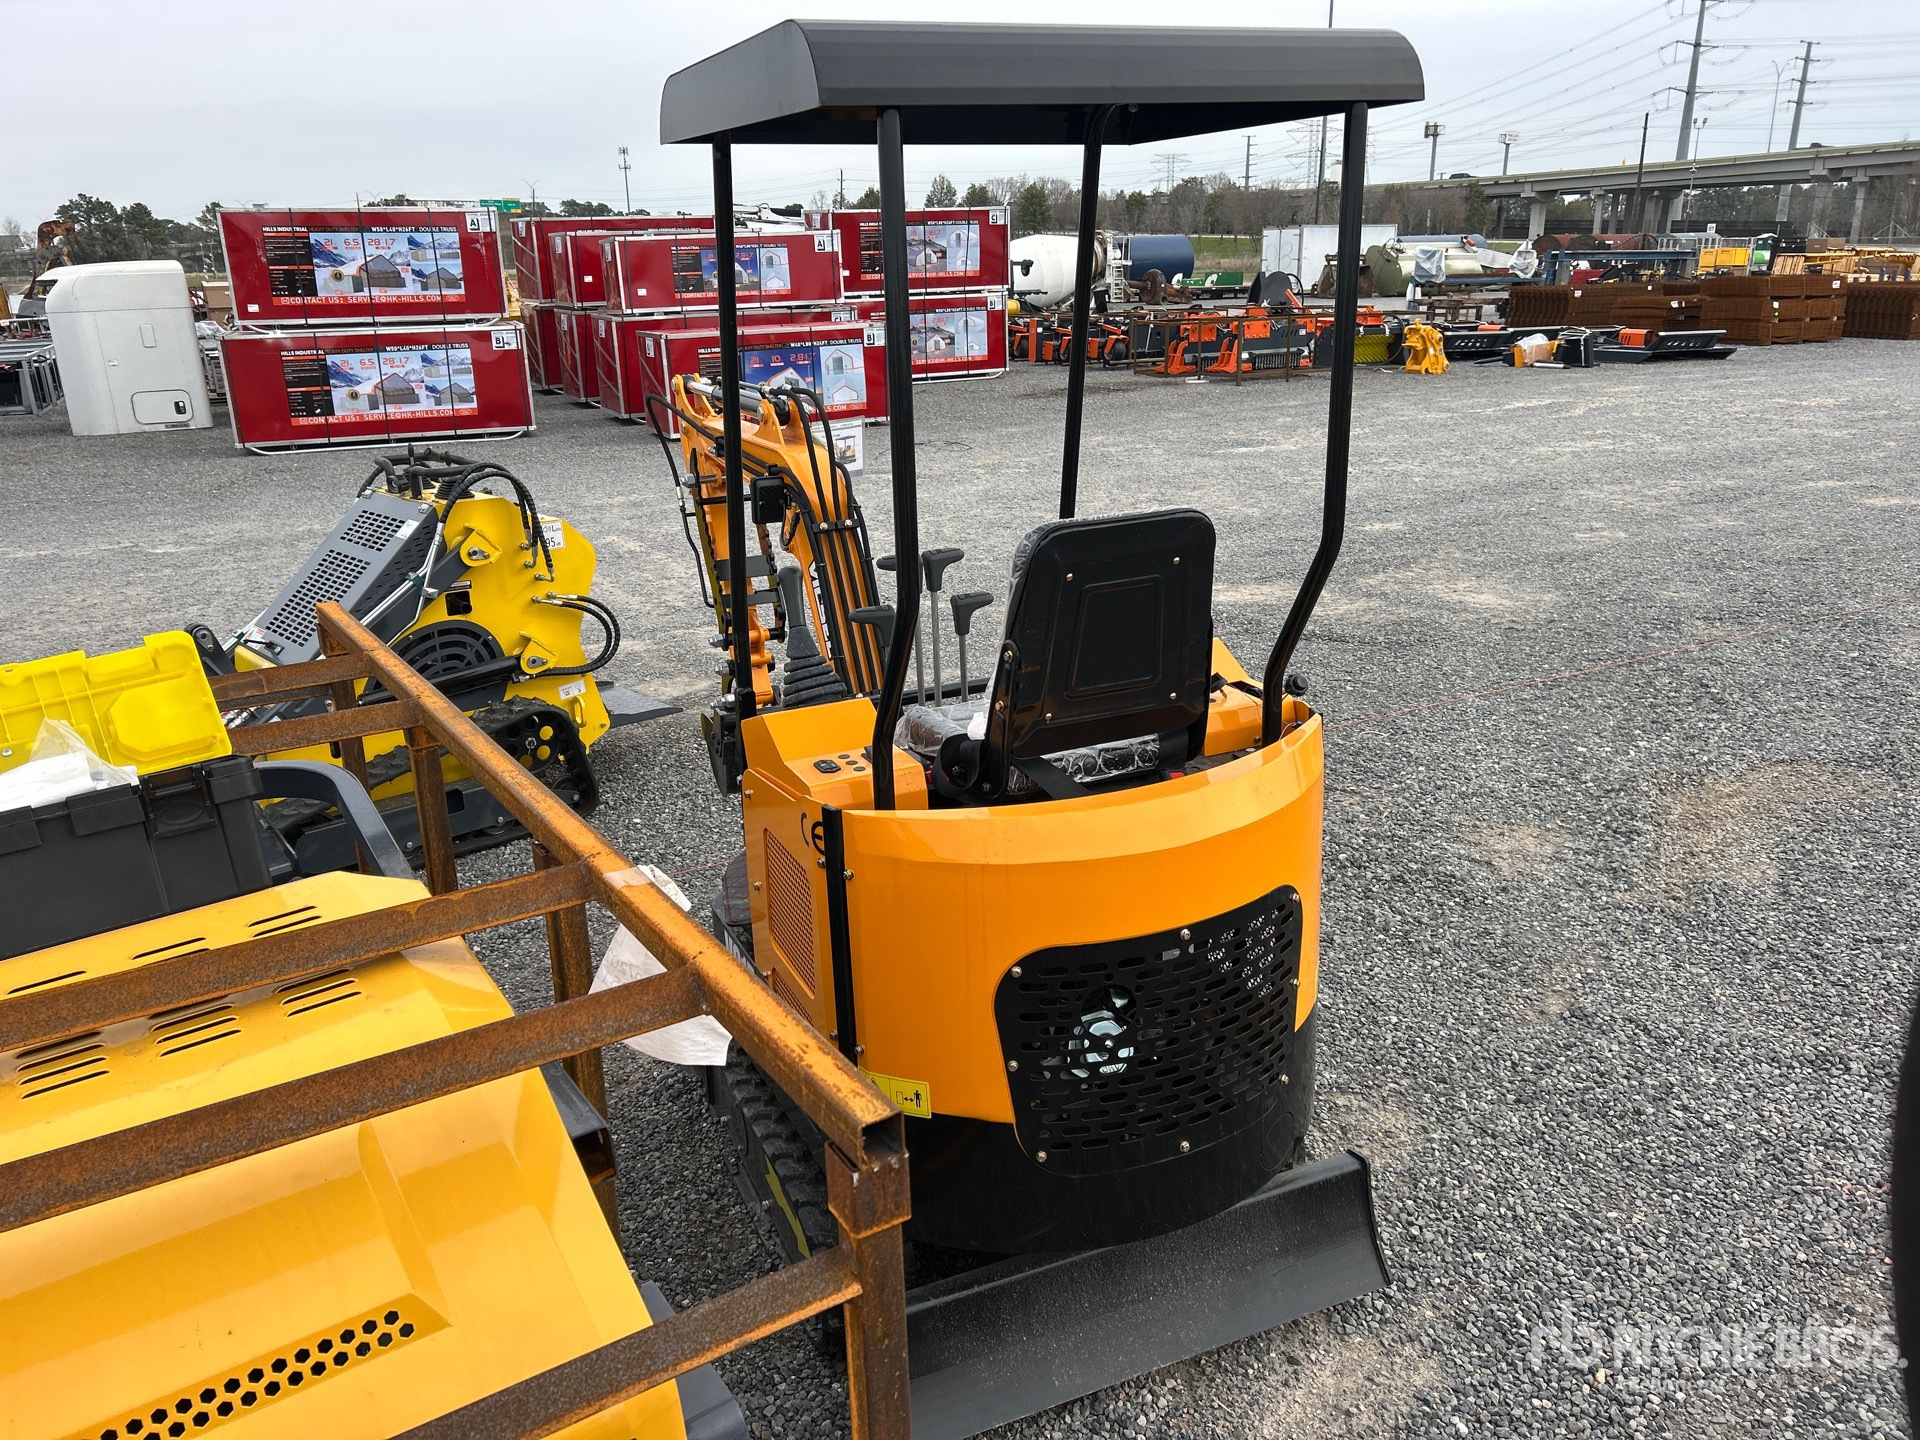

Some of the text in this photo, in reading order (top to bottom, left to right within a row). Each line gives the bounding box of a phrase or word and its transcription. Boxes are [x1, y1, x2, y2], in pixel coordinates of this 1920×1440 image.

[470, 219, 476, 227] A
[817, 240, 823, 248] A
[495, 337, 501, 345] B
